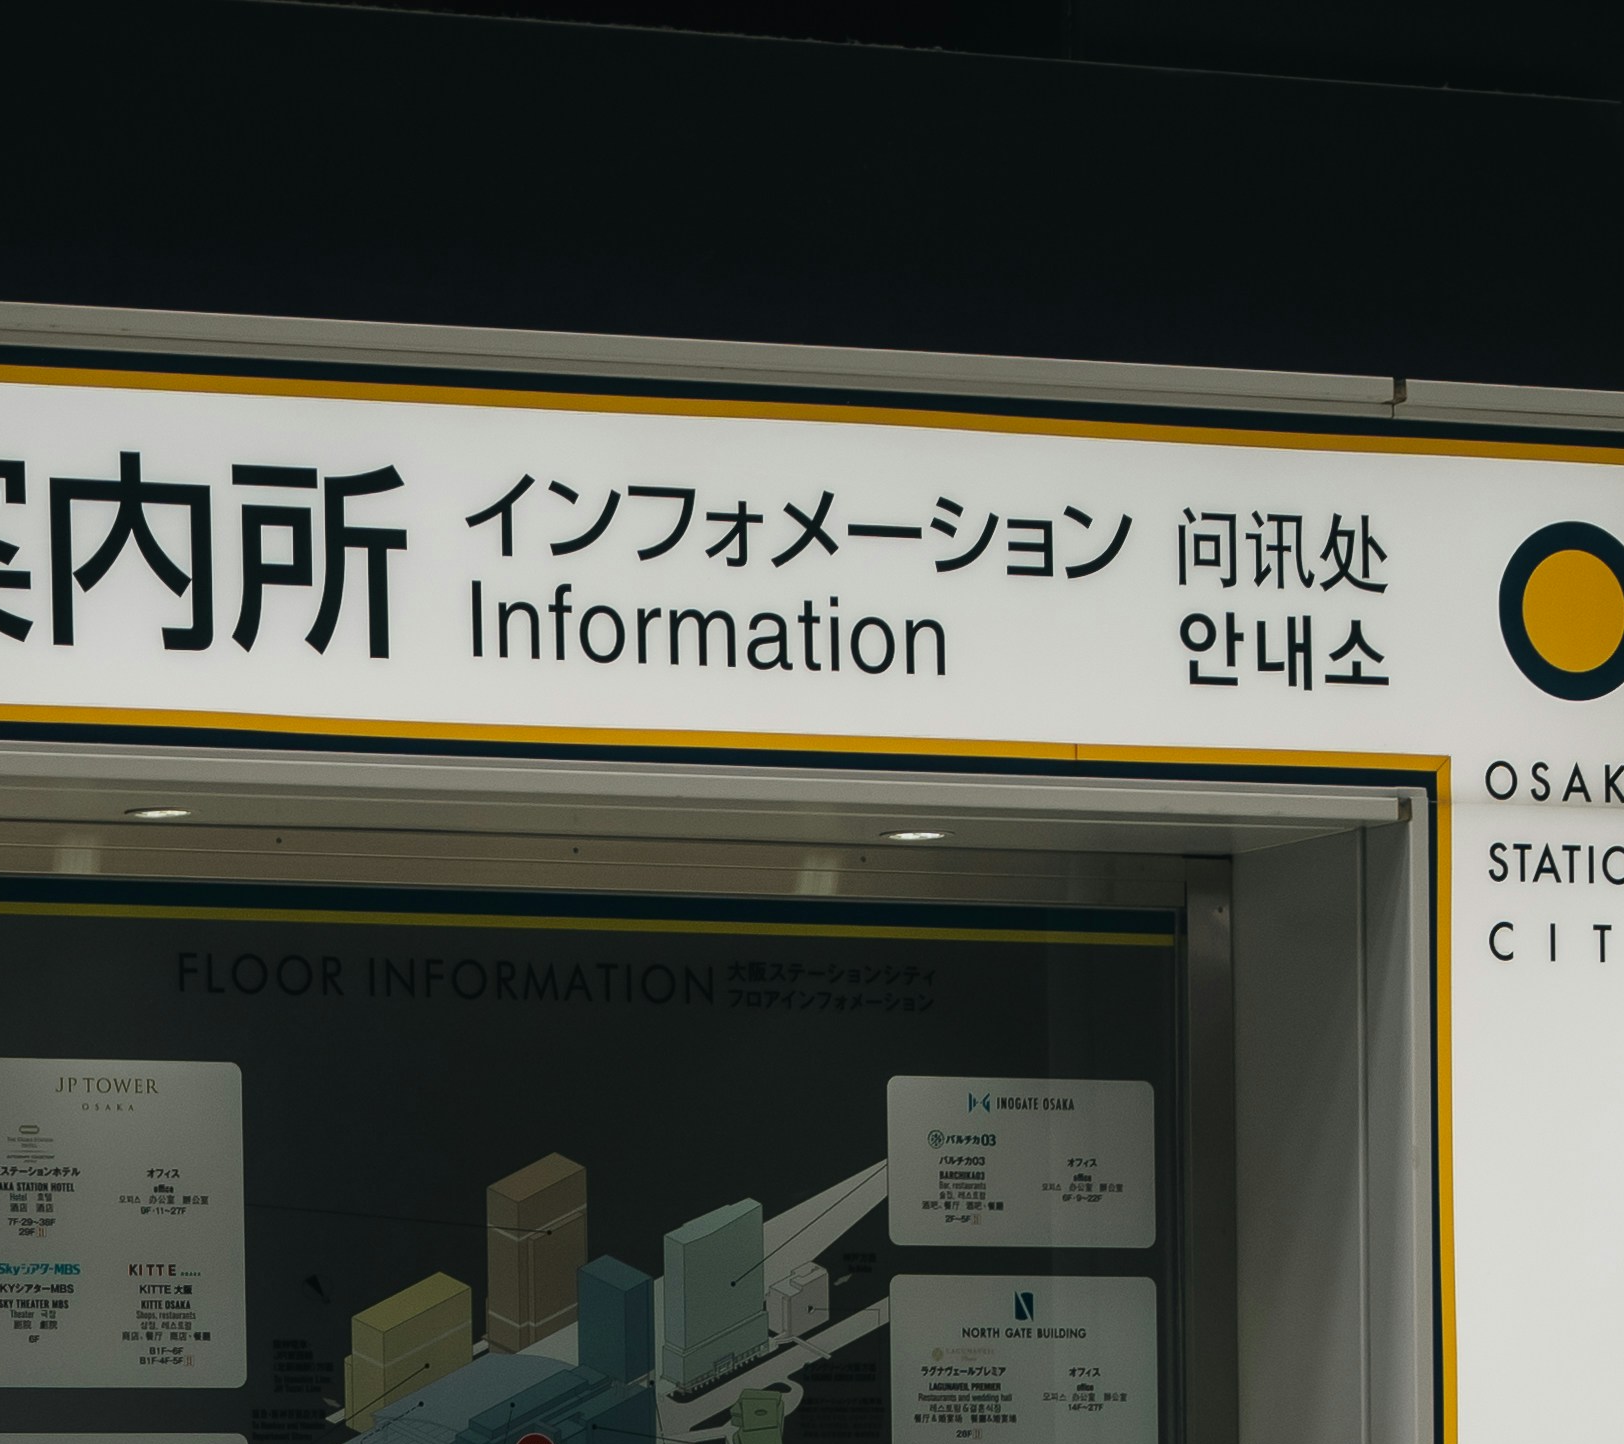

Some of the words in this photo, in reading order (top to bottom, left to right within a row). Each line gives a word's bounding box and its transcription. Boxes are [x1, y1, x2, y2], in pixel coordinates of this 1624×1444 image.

[465, 474, 1133, 580] インフォメーション
[1177, 506, 1390, 594] 问讯处
[471, 580, 947, 677] Information
[1179, 612, 1391, 691] 안내소
[179, 953, 344, 996] FLOOR
[370, 957, 714, 1005] INFORMATION
[727, 961, 936, 986] 大阪ステーションシティ
[728, 988, 935, 1014] フロアインフォメーション
[56, 1077, 77, 1093] JP
[83, 1077, 158, 1094] TOWER
[82, 1103, 134, 1111] OSAKA
[997, 1097, 1038, 1110] INOGATE
[1043, 1098, 1074, 1110] OSAKA
[946, 1134, 996, 1146] バルチカ03
[1067, 1158, 1097, 1168] オフィス
[146, 1168, 180, 1178] オフィス
[17, 1182, 48, 1191] STATION
[51, 1182, 75, 1192] HOTEL
[129, 1264, 176, 1276] KITTE
[139, 1285, 171, 1294] KITTE
[174, 1285, 192, 1295] 大阪
[0, 1299, 13, 1308] SKY
[16, 1299, 49, 1309] THEATER
[53, 1300, 69, 1309] MBS
[141, 1300, 162, 1309] KITTE
[165, 1300, 191, 1309] OSAKA
[962, 1328, 1000, 1338] NORTH
[1005, 1328, 1031, 1338] GATE
[1037, 1328, 1086, 1339] BUILDING
[921, 1366, 1006, 1377] ラグナヴェールプレミア
[1069, 1367, 1101, 1378] オフィス
[971, 1382, 1001, 1391] PREMIER
